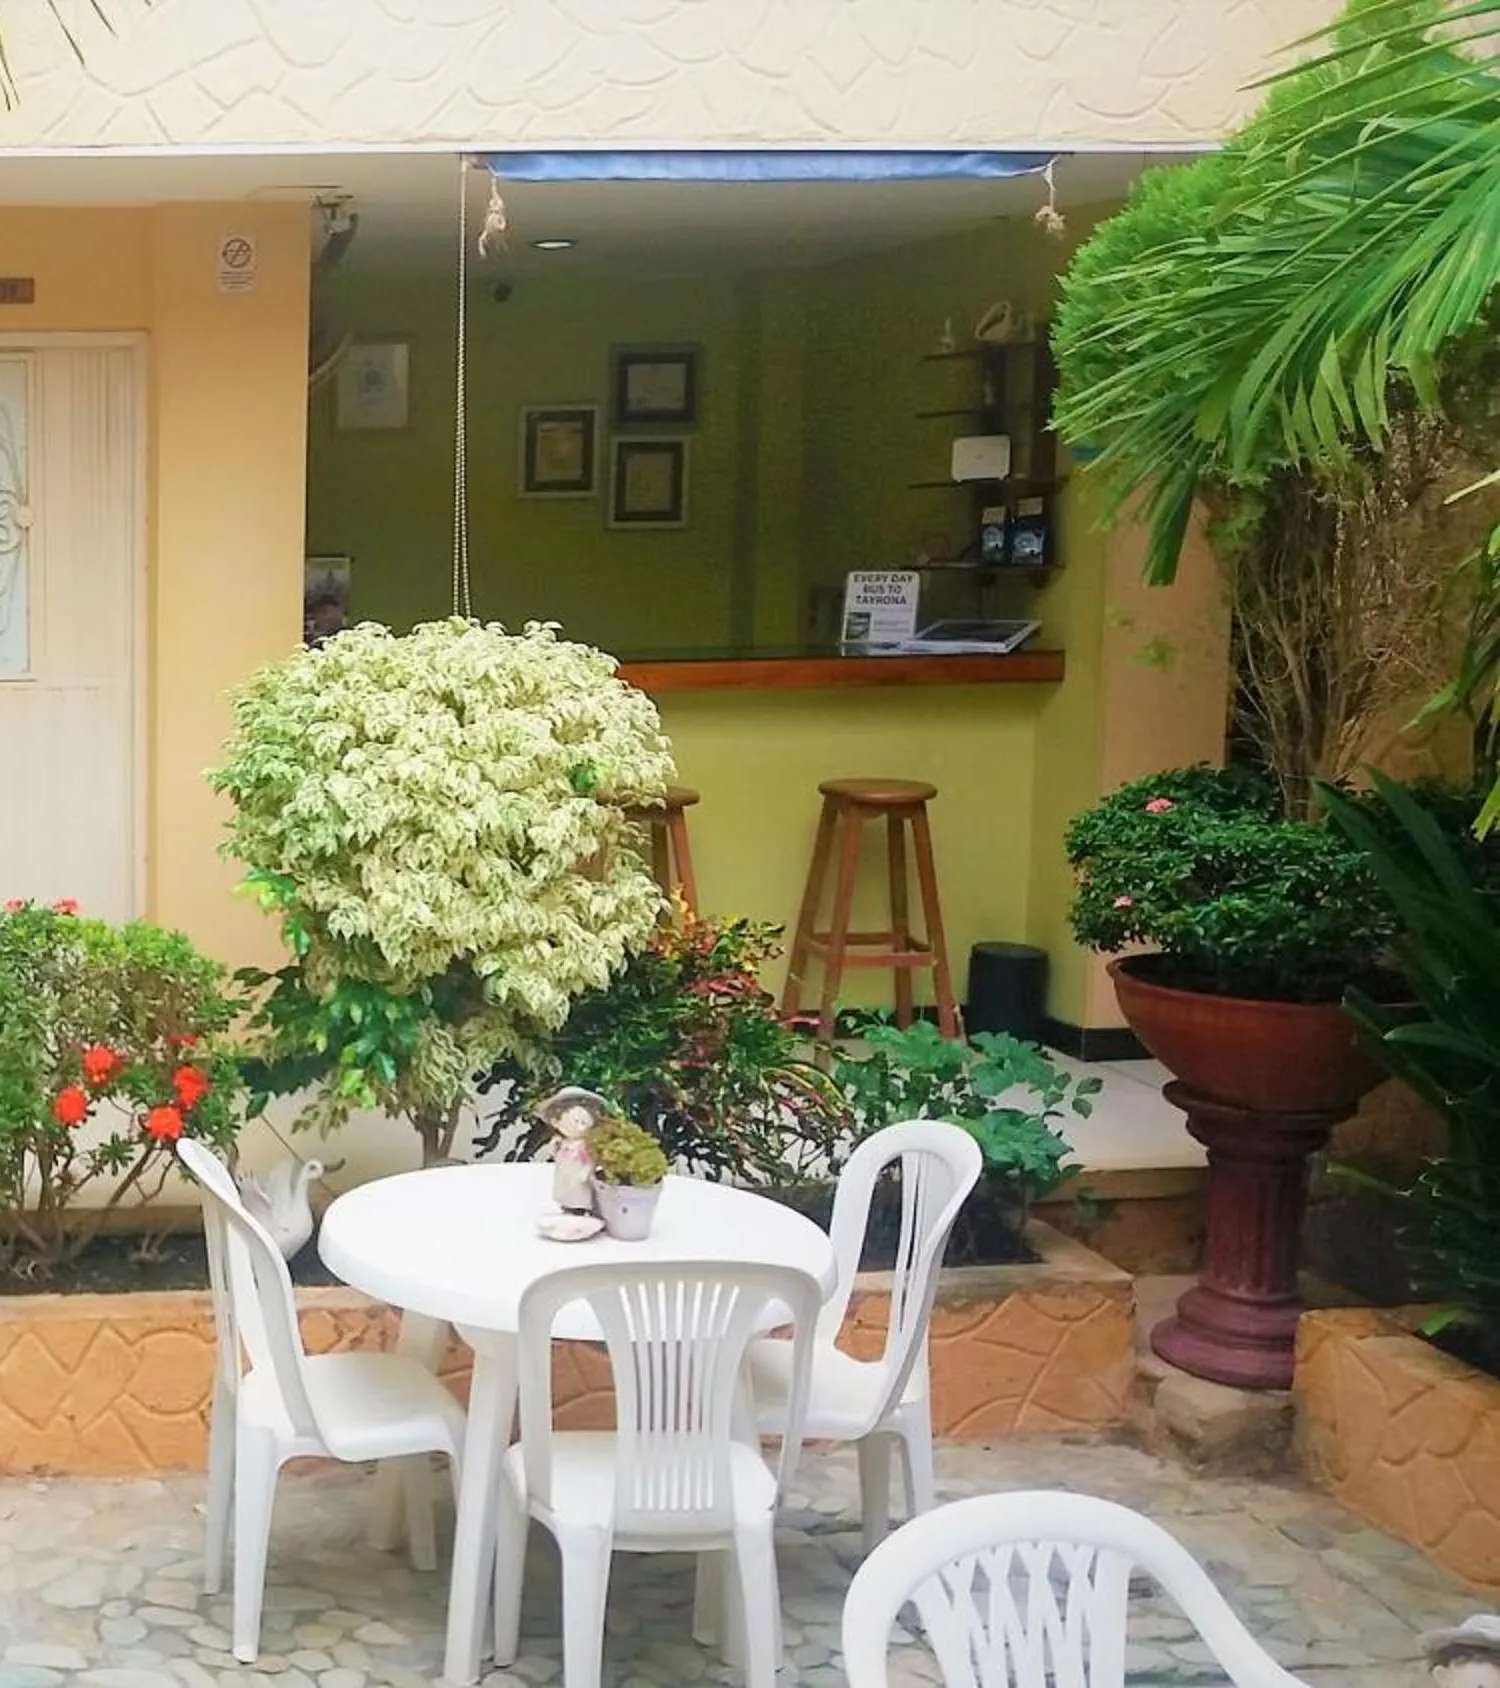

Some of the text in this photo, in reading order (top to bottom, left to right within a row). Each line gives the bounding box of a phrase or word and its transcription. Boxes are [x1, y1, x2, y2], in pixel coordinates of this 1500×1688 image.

[853, 574, 914, 583] EVERY DAY
[863, 584, 902, 594] BUS TO
[855, 595, 907, 605] TAYRONA
